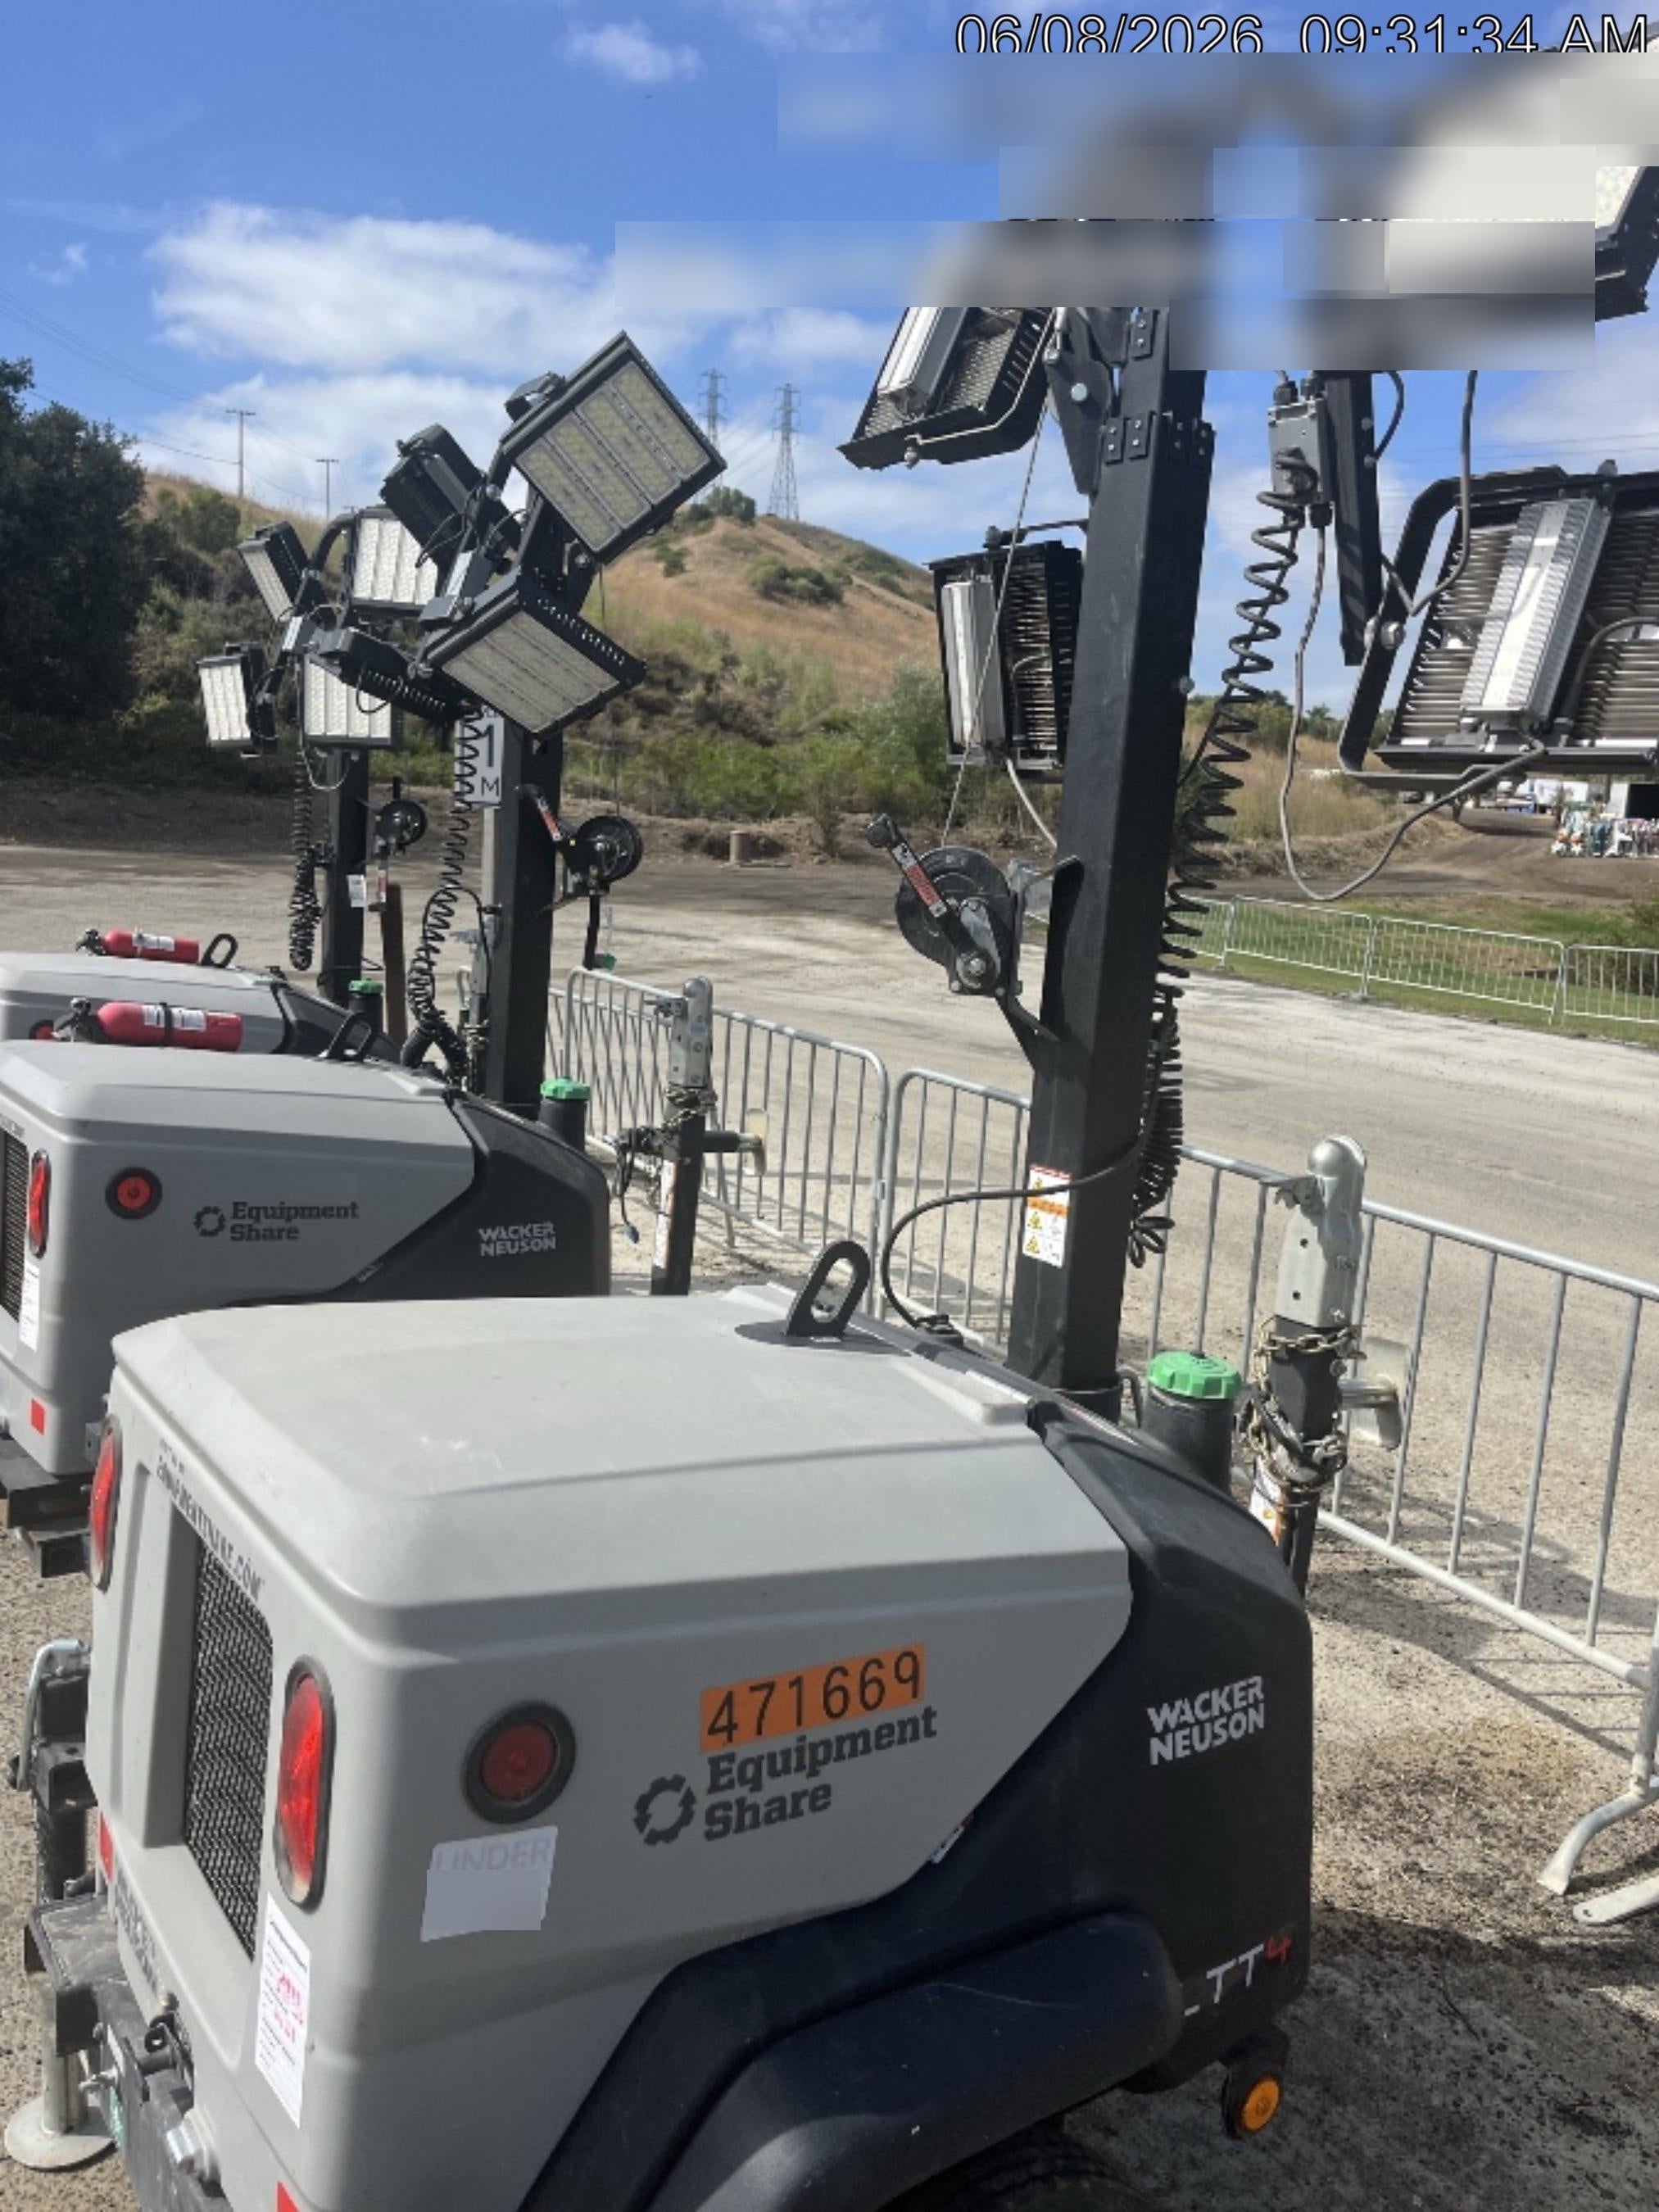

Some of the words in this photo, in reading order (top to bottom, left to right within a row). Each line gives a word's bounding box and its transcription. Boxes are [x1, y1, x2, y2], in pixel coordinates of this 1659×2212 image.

[230, 1201, 359, 1223] Equipment
[230, 1223, 300, 1241] Share
[478, 1222, 555, 1242] WACKER
[480, 1236, 556, 1256] NEUSON
[707, 1651, 921, 1743] 471669
[1147, 1675, 1264, 1733] WACKER
[706, 1706, 937, 1793] Equipment
[1149, 1703, 1264, 1766] NEUSON
[703, 1783, 832, 1842] Share
